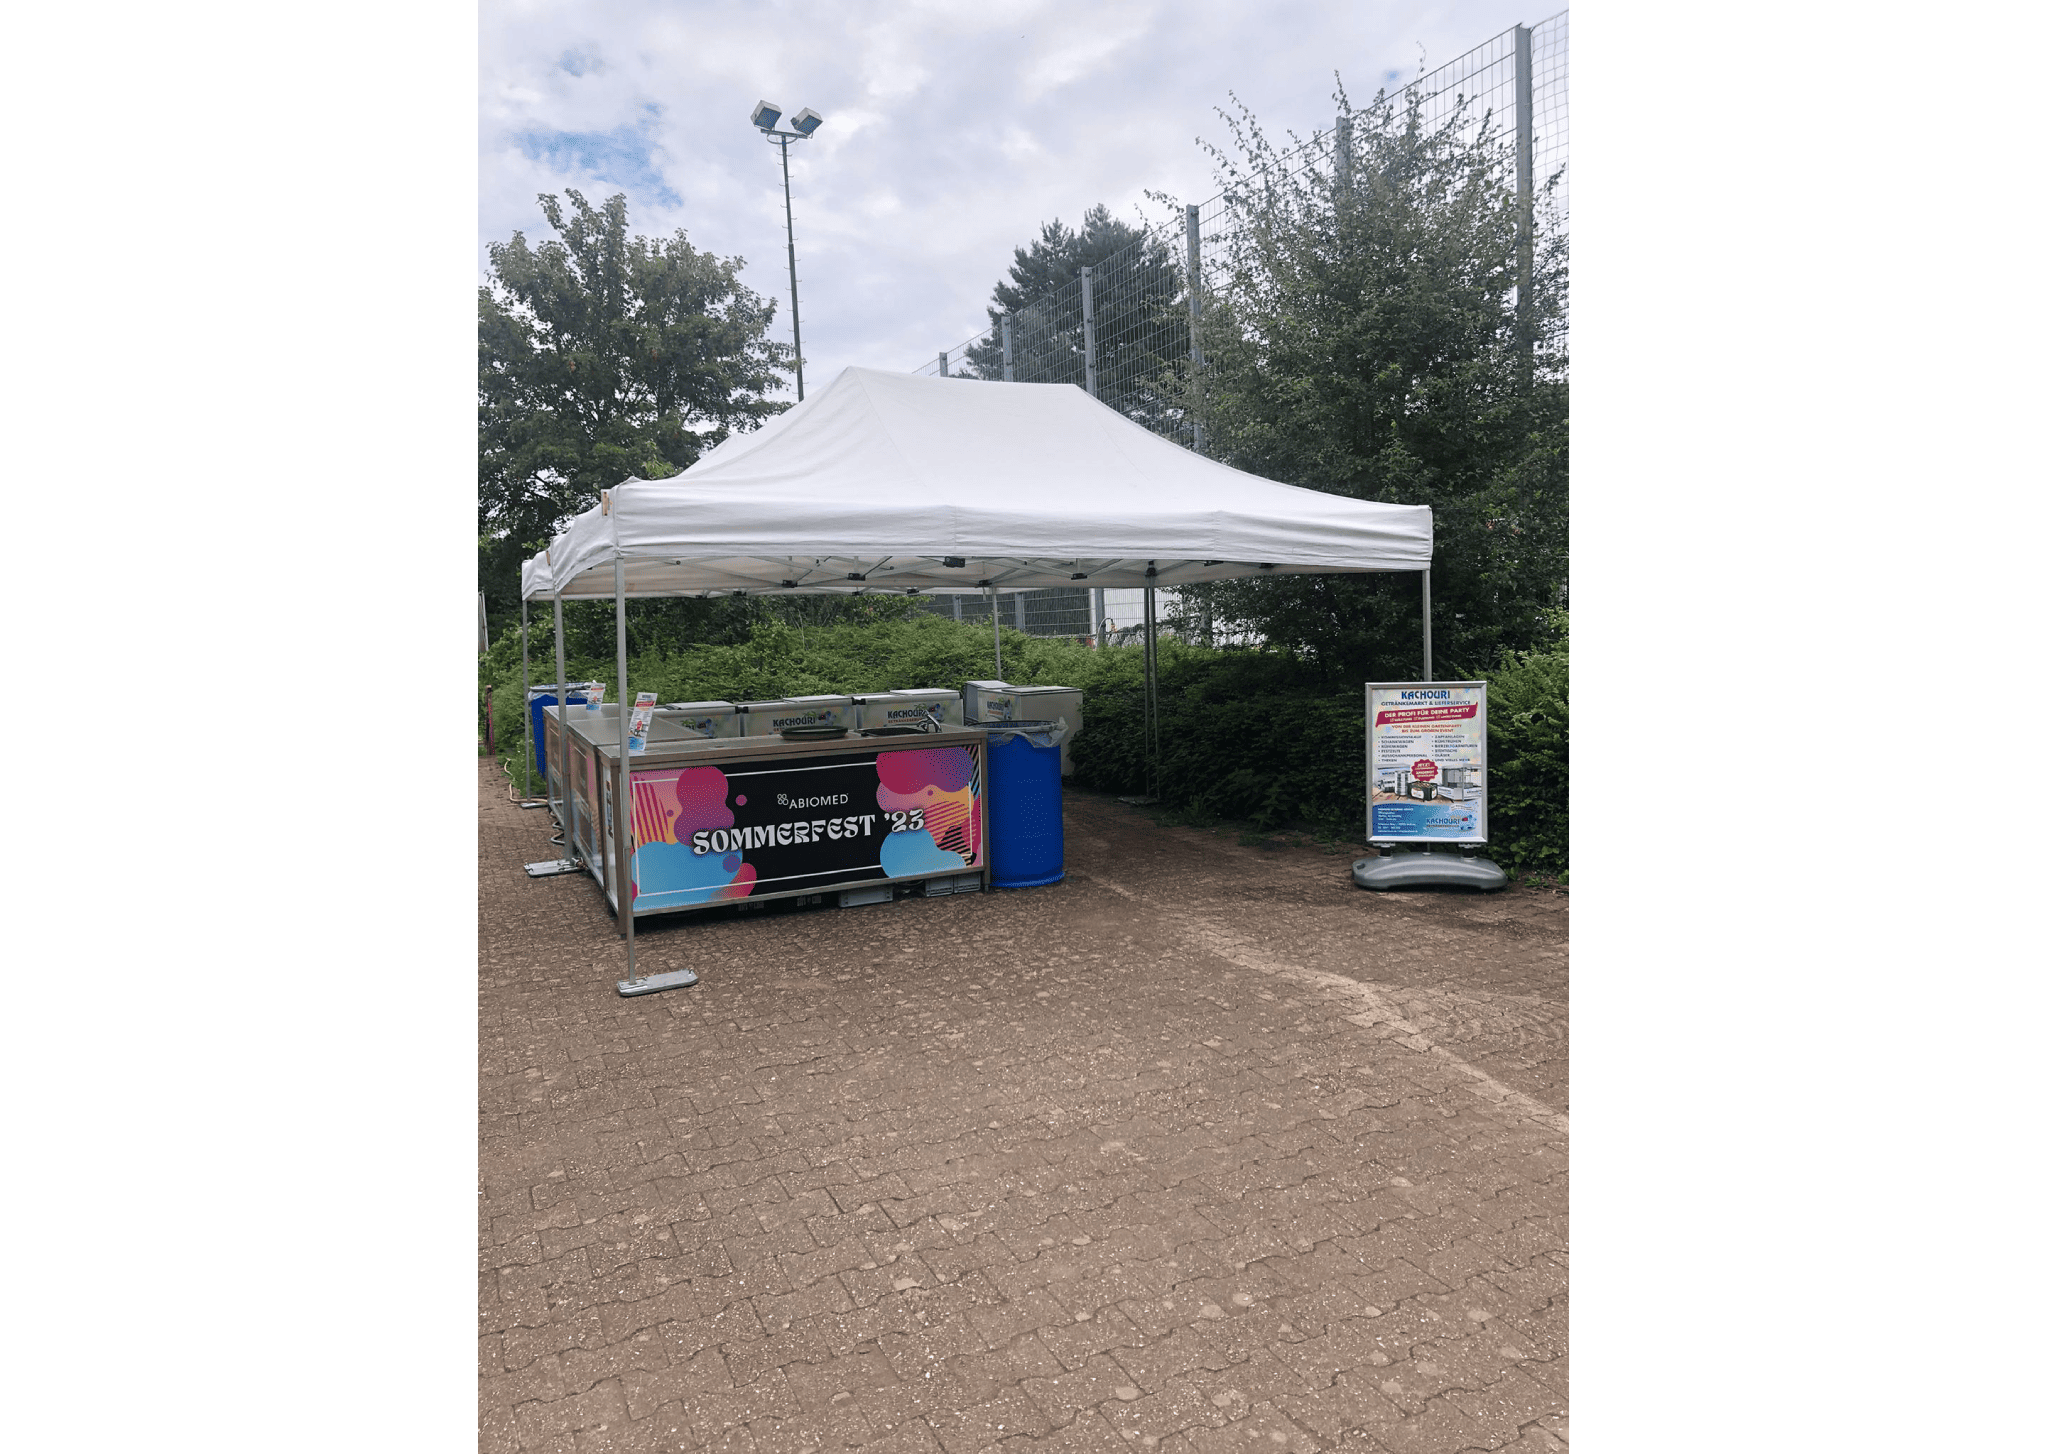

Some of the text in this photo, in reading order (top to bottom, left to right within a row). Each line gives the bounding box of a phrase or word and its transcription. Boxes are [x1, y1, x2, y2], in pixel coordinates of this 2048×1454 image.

[1402, 691, 1450, 699] KACHOURI
[773, 716, 816, 727] KACHOURI
[789, 794, 848, 809] ABIOMED
[693, 814, 876, 855] SOMMERFEST
